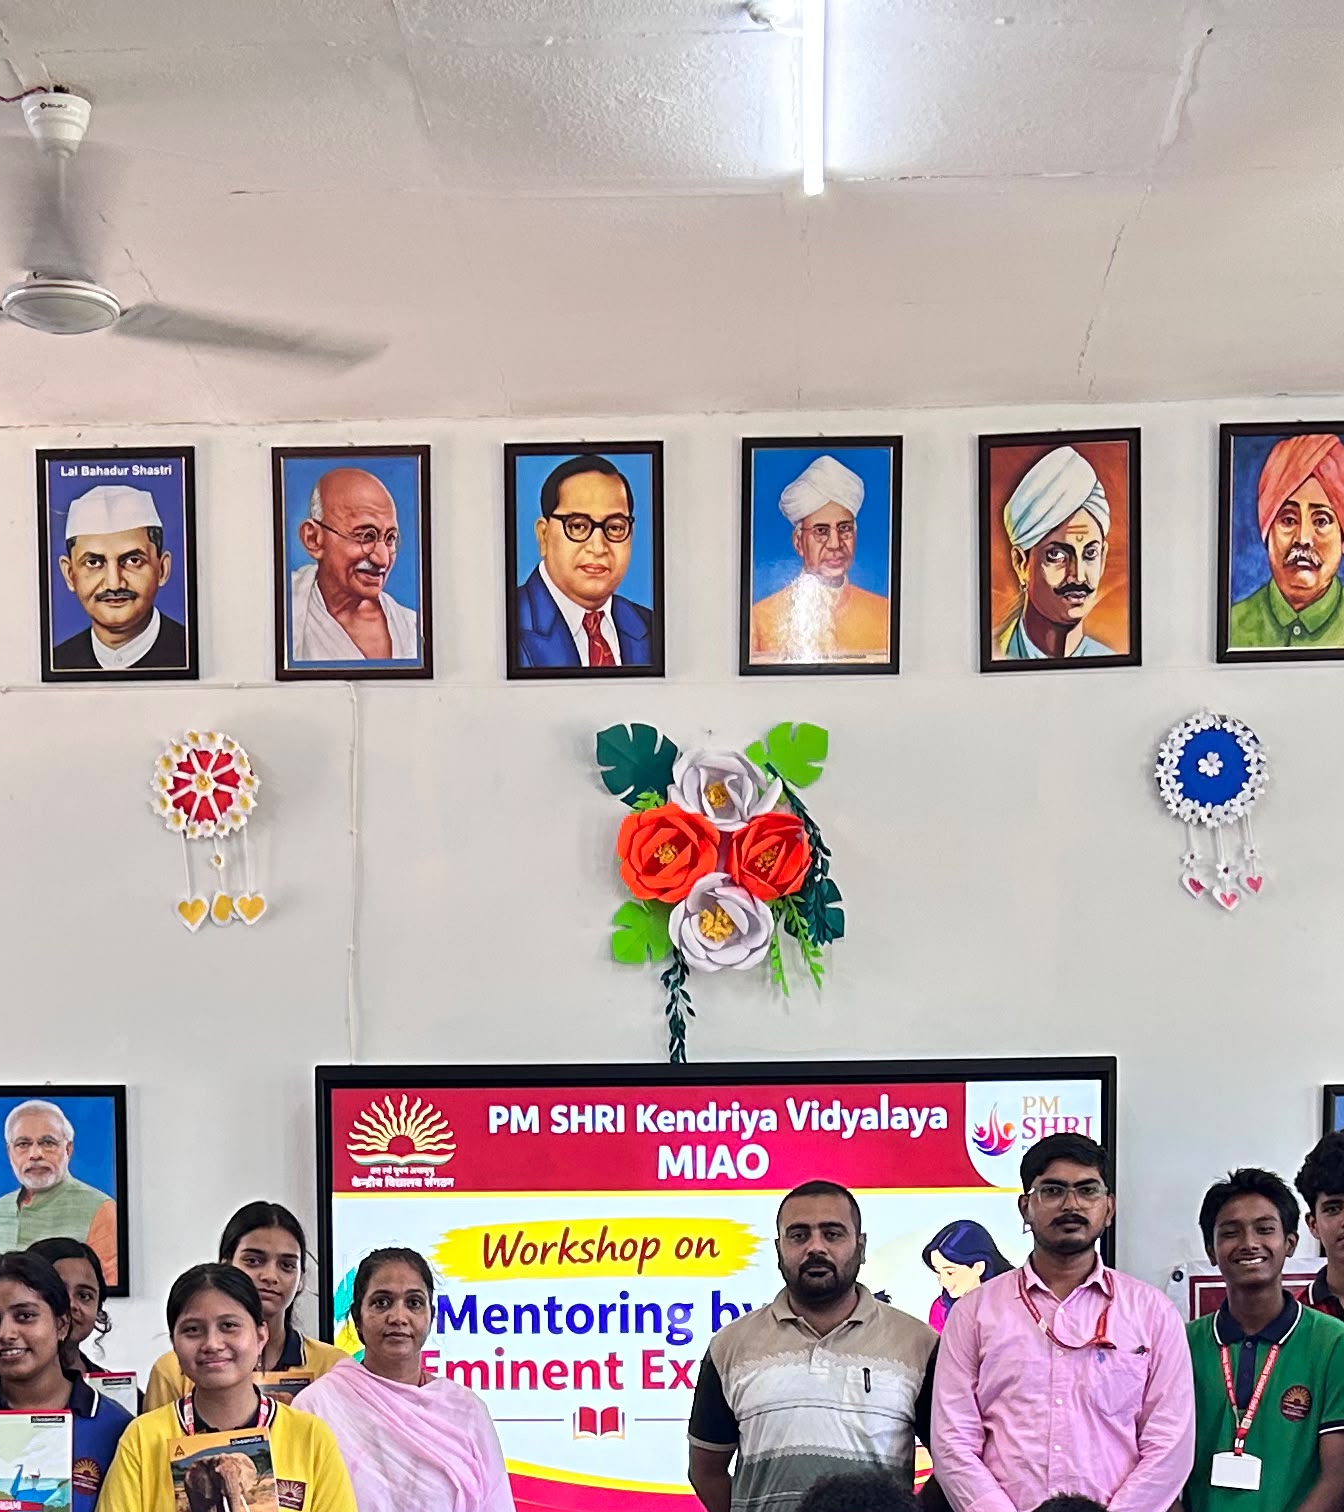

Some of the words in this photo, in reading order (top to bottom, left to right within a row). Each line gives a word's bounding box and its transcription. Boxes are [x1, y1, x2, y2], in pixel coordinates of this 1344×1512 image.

[61, 465, 78, 477] Lal
[80, 464, 129, 477] Bahadur
[131, 463, 173, 476] Shastri
[488, 1104, 540, 1134] PM
[550, 1104, 625, 1134] SHRI
[635, 1100, 778, 1141] Kendriya
[785, 1094, 948, 1140] Vidyalaya
[1022, 1095, 1060, 1116] PM
[1021, 1115, 1093, 1140] SHRI
[657, 1144, 770, 1180] MIAO
[483, 1225, 660, 1275] Workshop
[675, 1235, 720, 1260] on
[436, 1290, 694, 1347] Mentoring
[711, 1290, 766, 1334] b
[420, 1346, 624, 1391] Eminent
[642, 1350, 704, 1391] Ex
